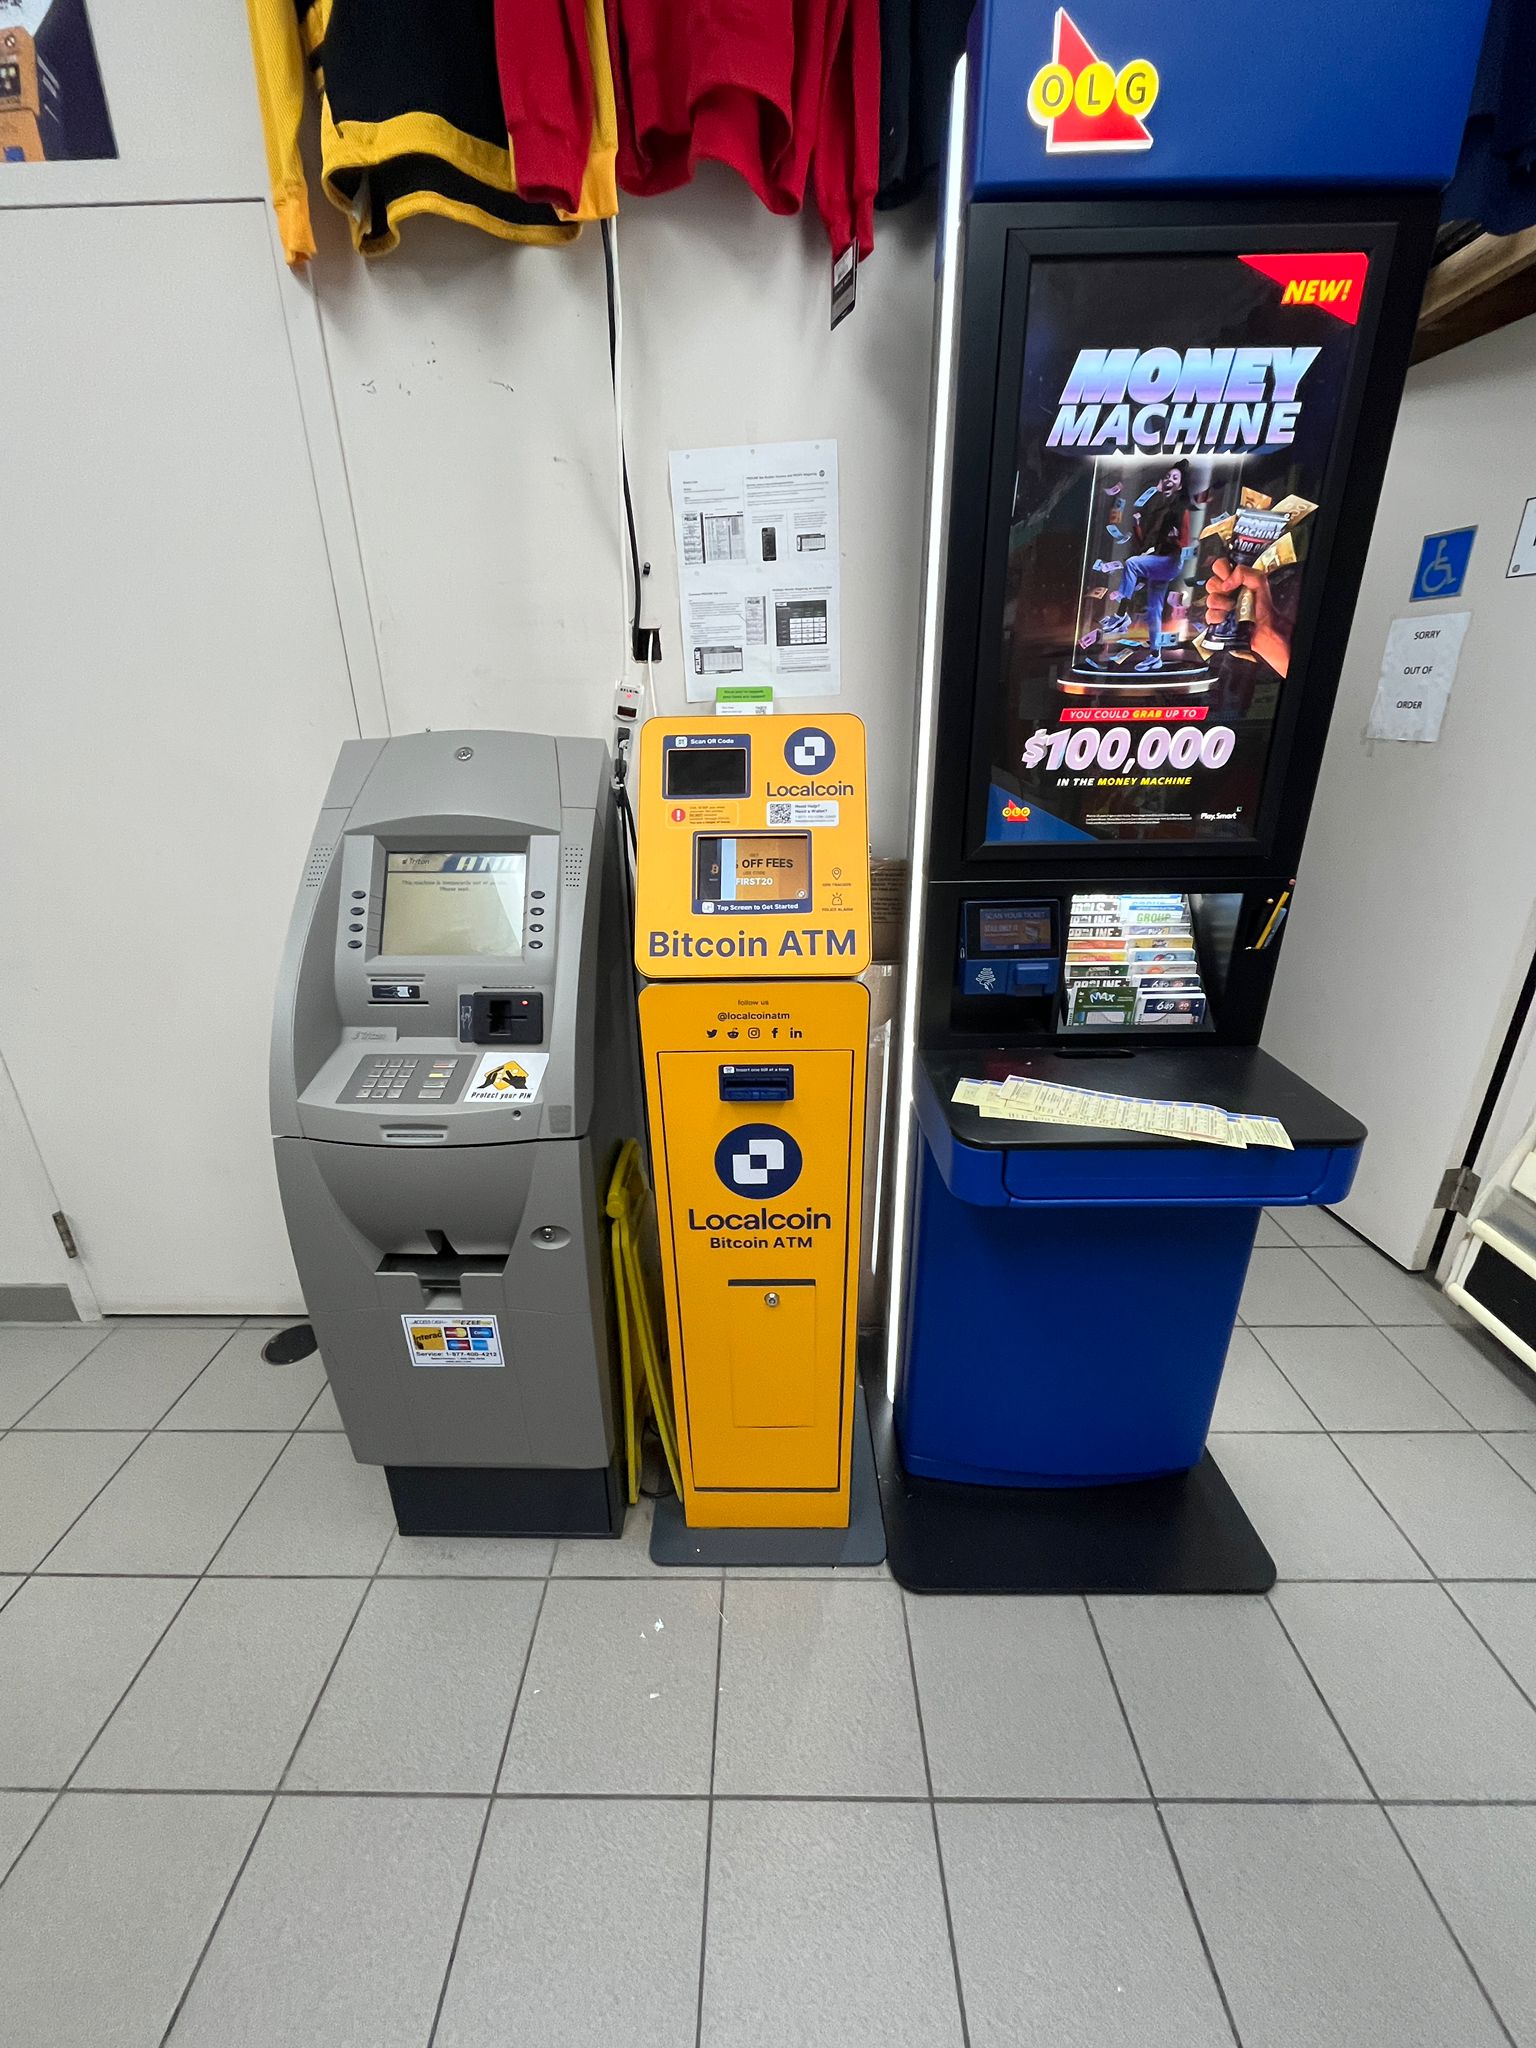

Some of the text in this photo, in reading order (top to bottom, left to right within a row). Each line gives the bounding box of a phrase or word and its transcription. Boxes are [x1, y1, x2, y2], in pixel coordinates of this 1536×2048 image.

[1041, 72, 1146, 107] OLG
[1281, 279, 1352, 304] NEW!
[1058, 346, 1322, 404] MONEY
[1045, 402, 1302, 450] MACHINE
[1233, 525, 1282, 540] MACHINE
[1413, 630, 1441, 640] SORRY
[1403, 665, 1433, 675] OUT OF
[1396, 700, 1423, 710] ORDER
[1069, 709, 1197, 719] YOU COULD GRAB UP TO
[1021, 726, 1236, 774] $100,000
[1056, 776, 1192, 787] IN THE MONEY MACHINE
[766, 780, 854, 797] Localcoin
[408, 857, 430, 865] Triton
[741, 858, 794, 869] OFF FEES
[736, 877, 773, 886] FIRST20
[649, 929, 856, 957] Bitcoin ATM
[1089, 991, 1116, 1004] MAX
[717, 1011, 790, 1021] @localcoinatm
[471, 1091, 499, 1099] Protect
[688, 1207, 832, 1231] Localcoin
[710, 1235, 813, 1249] Bitcoin ATM
[412, 1330, 443, 1341] Interac
